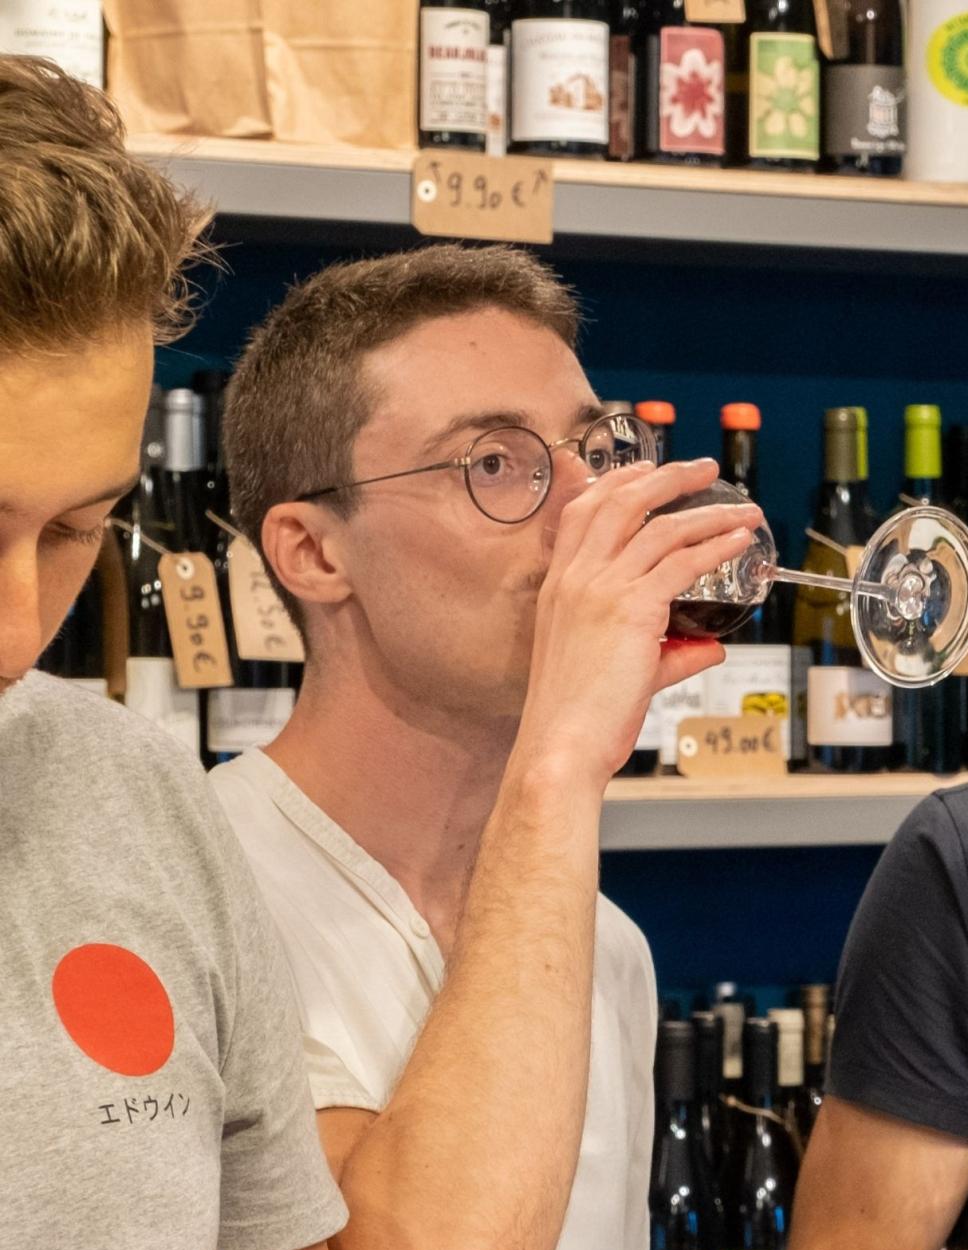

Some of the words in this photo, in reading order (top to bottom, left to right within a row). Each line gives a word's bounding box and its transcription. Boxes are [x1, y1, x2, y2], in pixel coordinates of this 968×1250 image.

[98, 1093, 190, 1125] エドウイン
